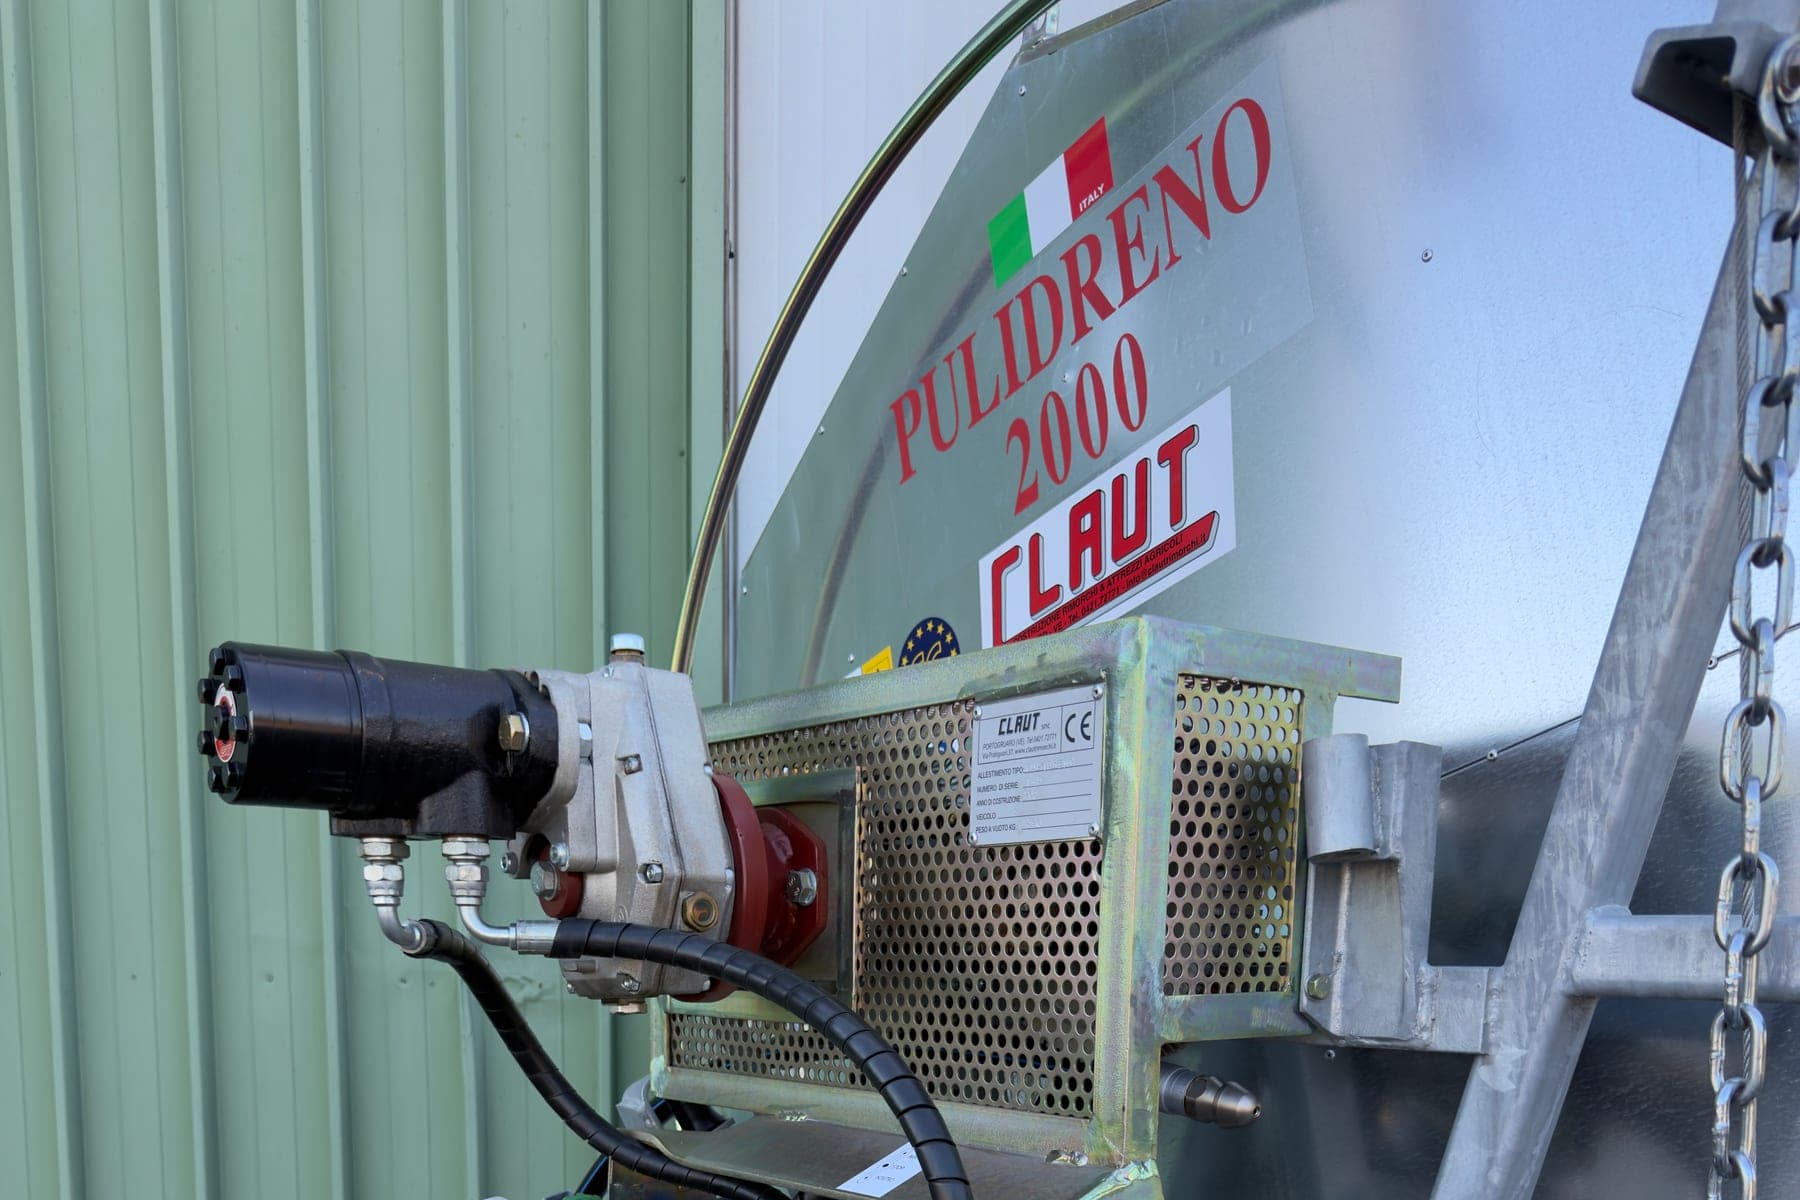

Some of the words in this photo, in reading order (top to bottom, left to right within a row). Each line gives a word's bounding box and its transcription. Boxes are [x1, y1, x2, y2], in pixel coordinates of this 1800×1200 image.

[1079, 183, 1104, 212] ITALY
[889, 97, 1272, 485] PULIDRENO
[1005, 332, 1148, 516] 2000
[991, 423, 1200, 646] CLAUT
[1062, 588, 1098, 615] RIMORCHI
[1107, 560, 1143, 586] ATTREZZI
[1144, 534, 1184, 565] AGRICOLI
[998, 712, 1040, 735] CLAUT
[977, 784, 998, 793] NUMERO
[998, 783, 1003, 791] DI
[978, 768, 1012, 779] ALLESTIMENTO
[976, 825, 988, 834] PESO
[992, 824, 1008, 832] VUOTO
